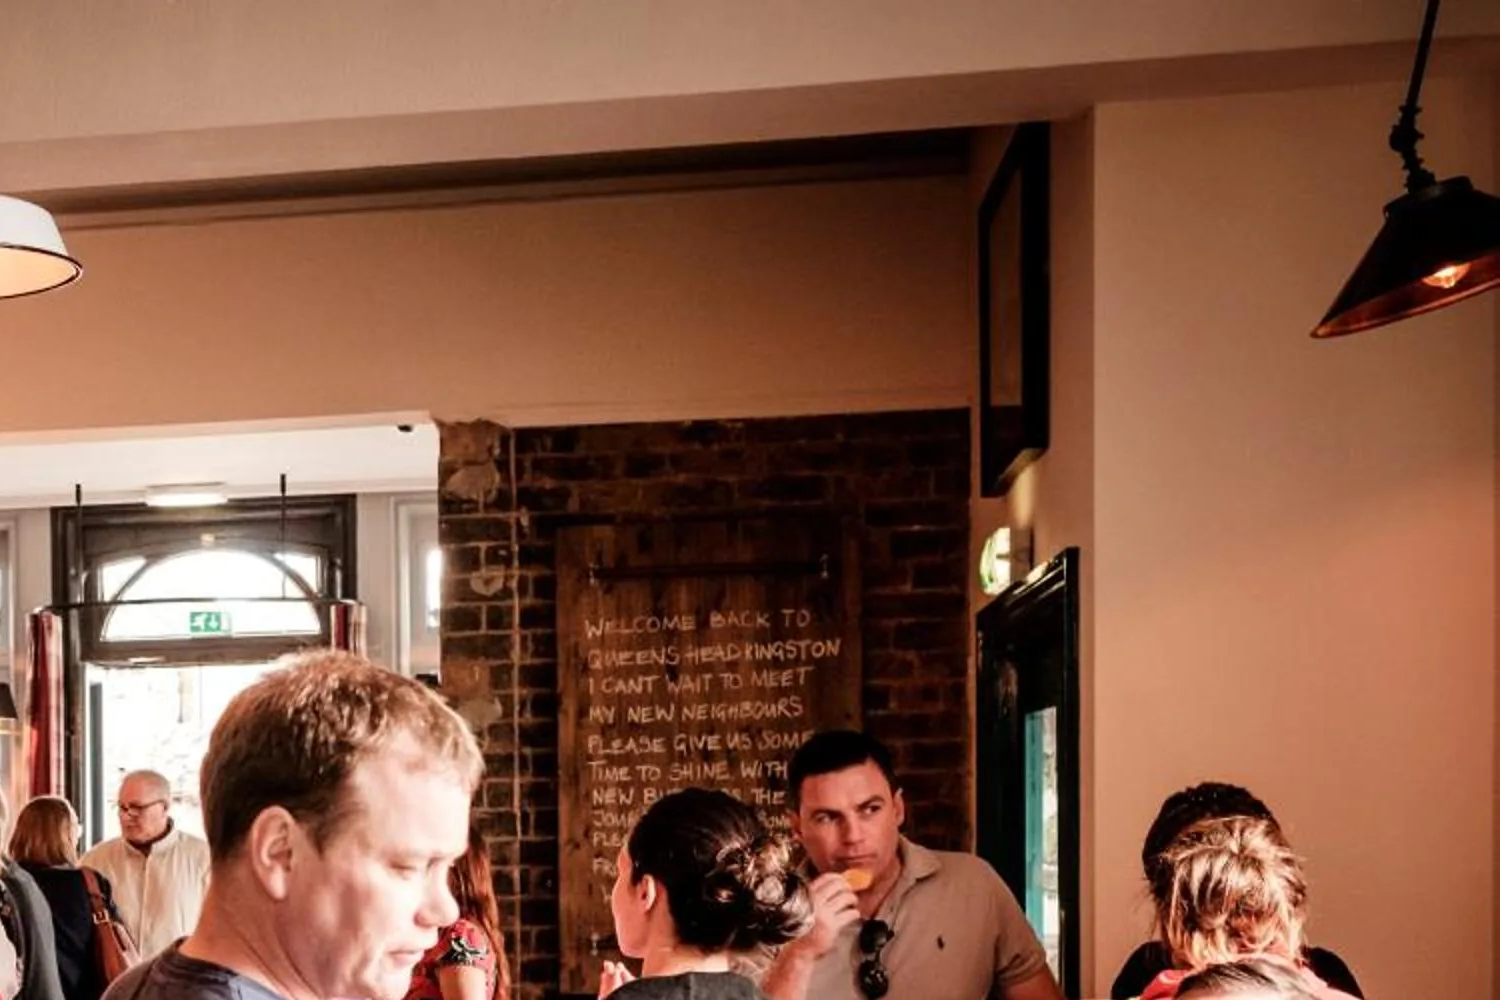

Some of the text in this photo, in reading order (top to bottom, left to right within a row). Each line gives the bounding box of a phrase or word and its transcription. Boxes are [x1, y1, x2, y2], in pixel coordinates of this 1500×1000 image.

[710, 609, 771, 628] BACK
[781, 608, 811, 628] TO
[587, 637, 842, 670] QUEENS HEAD KINGSTON
[589, 666, 816, 696] I CANT WAIT TO MEET
[589, 695, 804, 724] MY NEW NEIGHBOURS
[587, 733, 667, 755] PLEASE
[673, 733, 722, 756] GIVE
[725, 731, 752, 751] US
[587, 759, 789, 783] TIME TO SHINE WITH
[593, 786, 635, 807] NEW
[750, 787, 786, 806] THE
